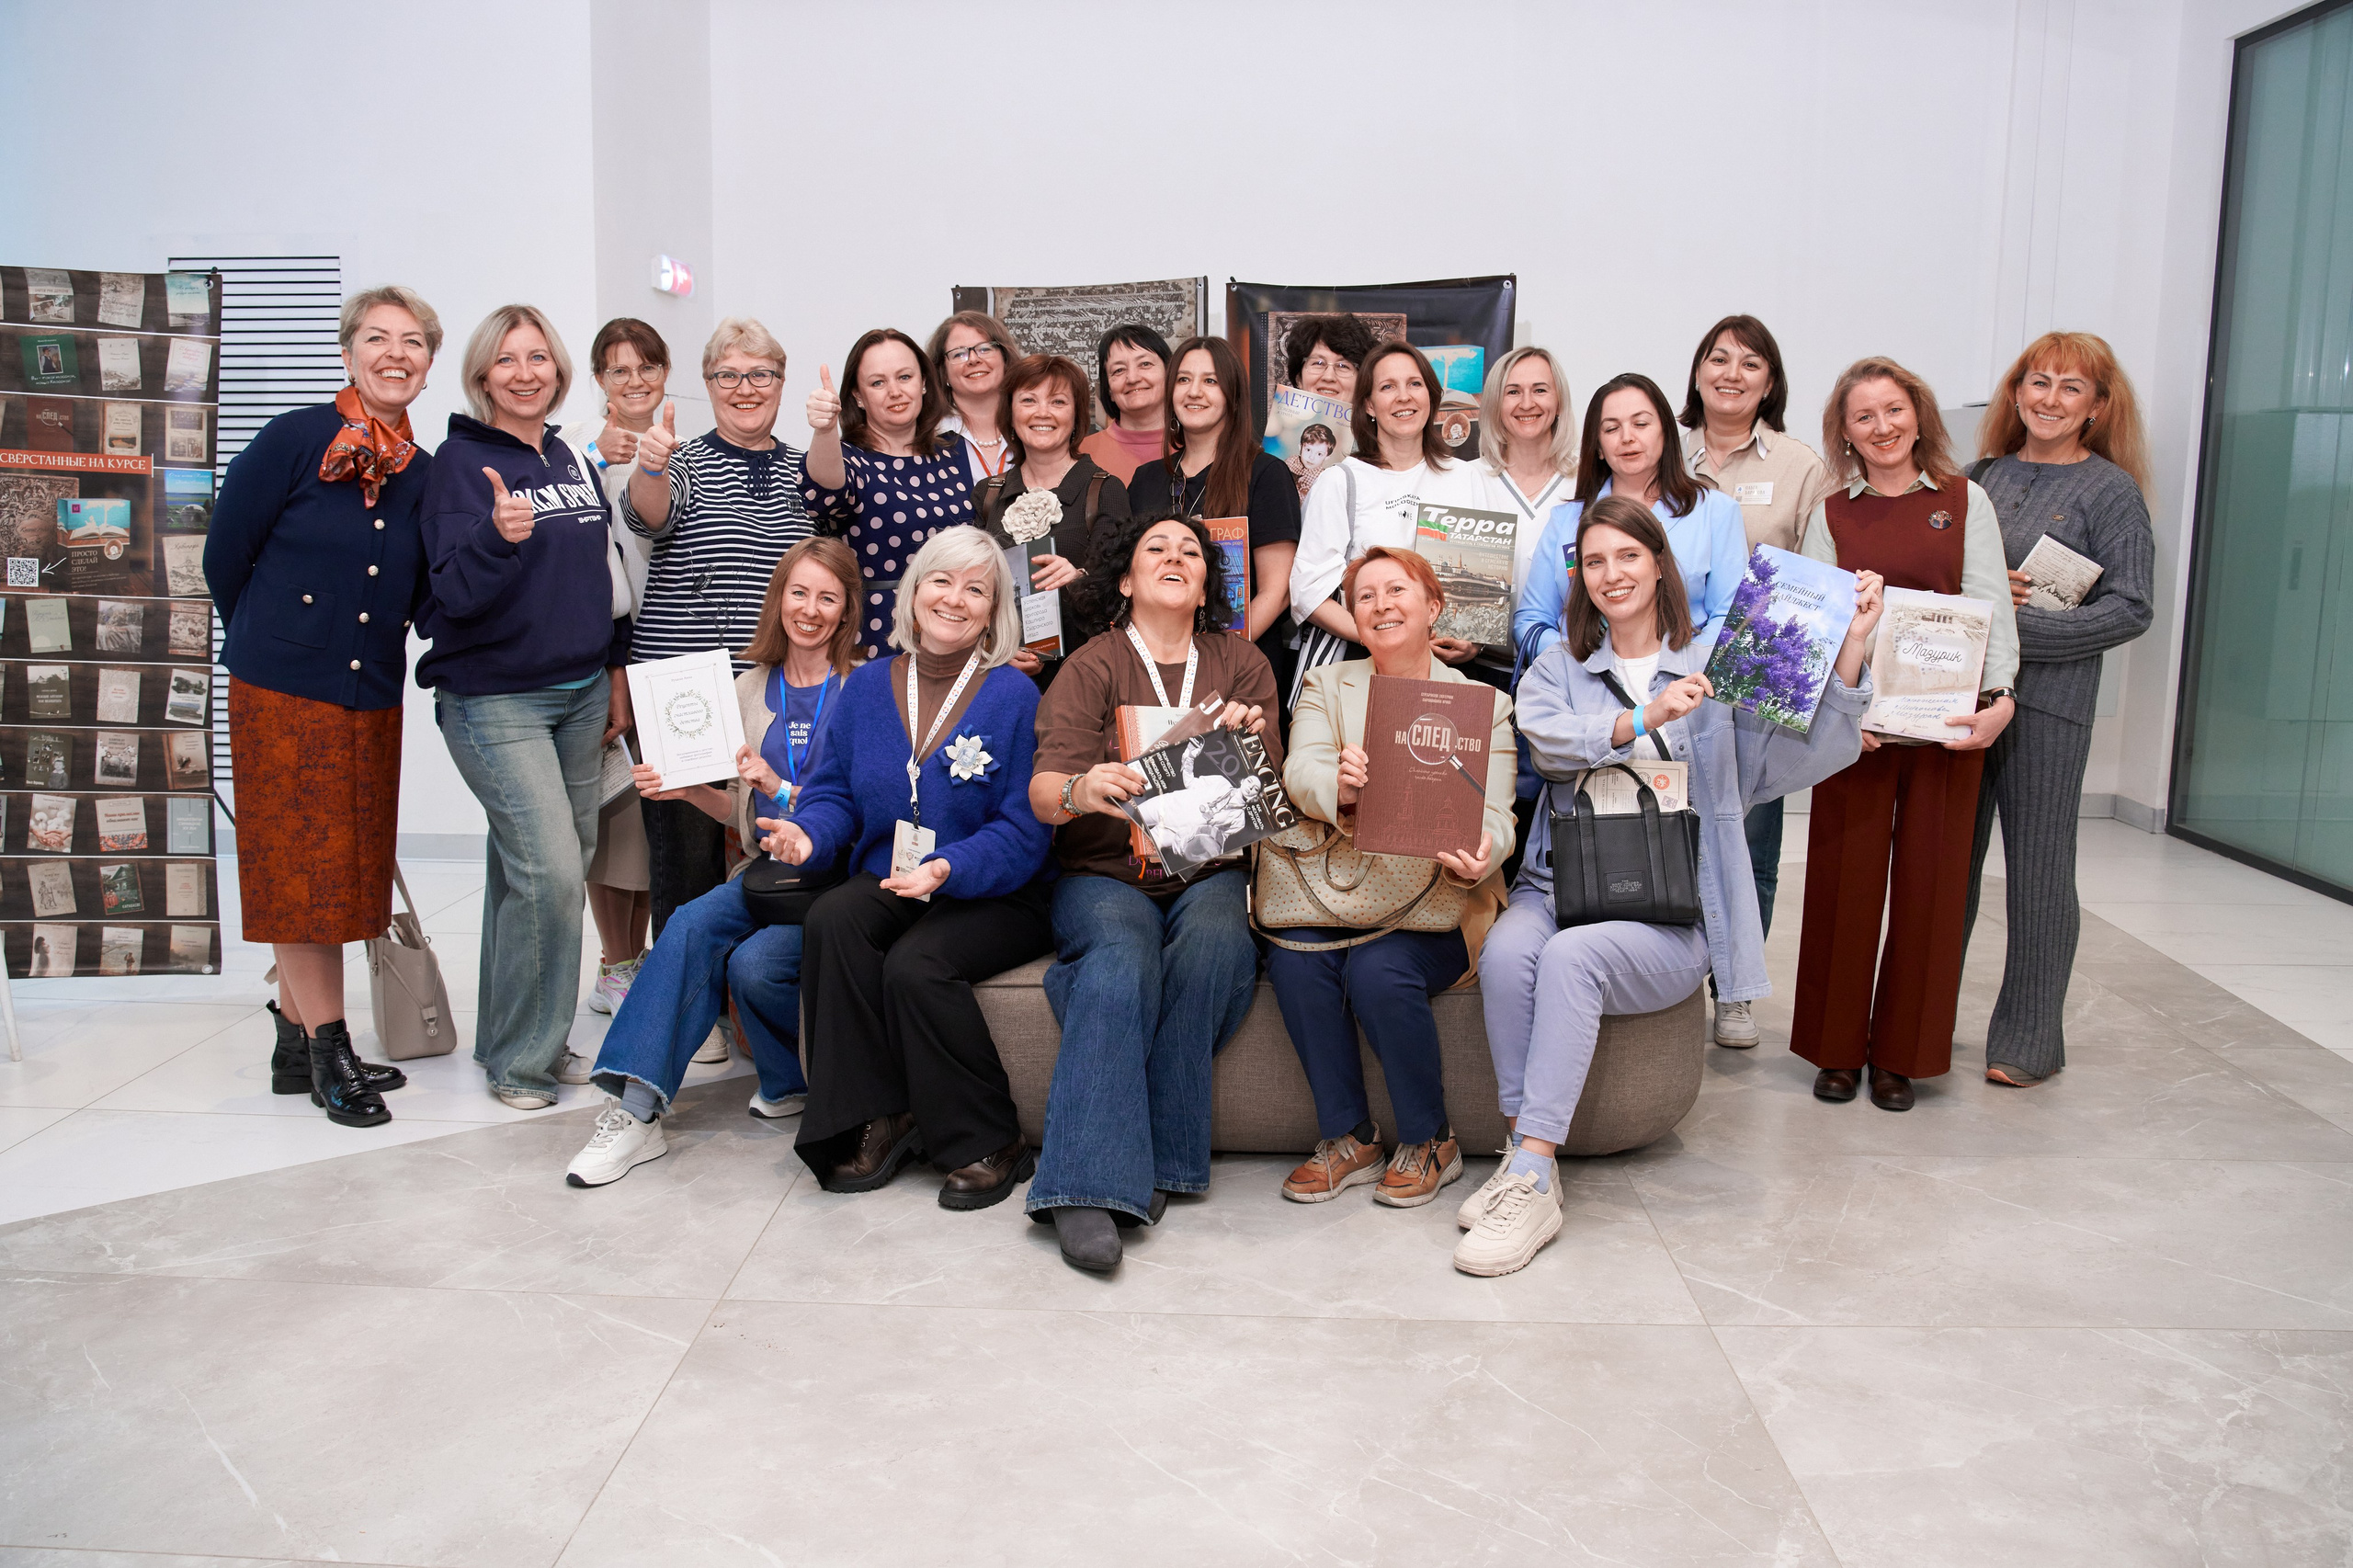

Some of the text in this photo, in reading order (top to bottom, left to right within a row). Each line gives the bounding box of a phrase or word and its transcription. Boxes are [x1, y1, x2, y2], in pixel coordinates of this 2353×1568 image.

[0, 452, 146, 471] СВЁРСТАННЫЕ НА КУРСЕ
[1423, 506, 1516, 535] Терра
[1449, 531, 1513, 546] ТАТАРСТАН
[71, 557, 98, 565] СДЕЛАЙ
[1773, 590, 1821, 612] ДАЙДЖЕСТ
[1903, 642, 1963, 663] Мазурик
[789, 737, 809, 746] quoi
